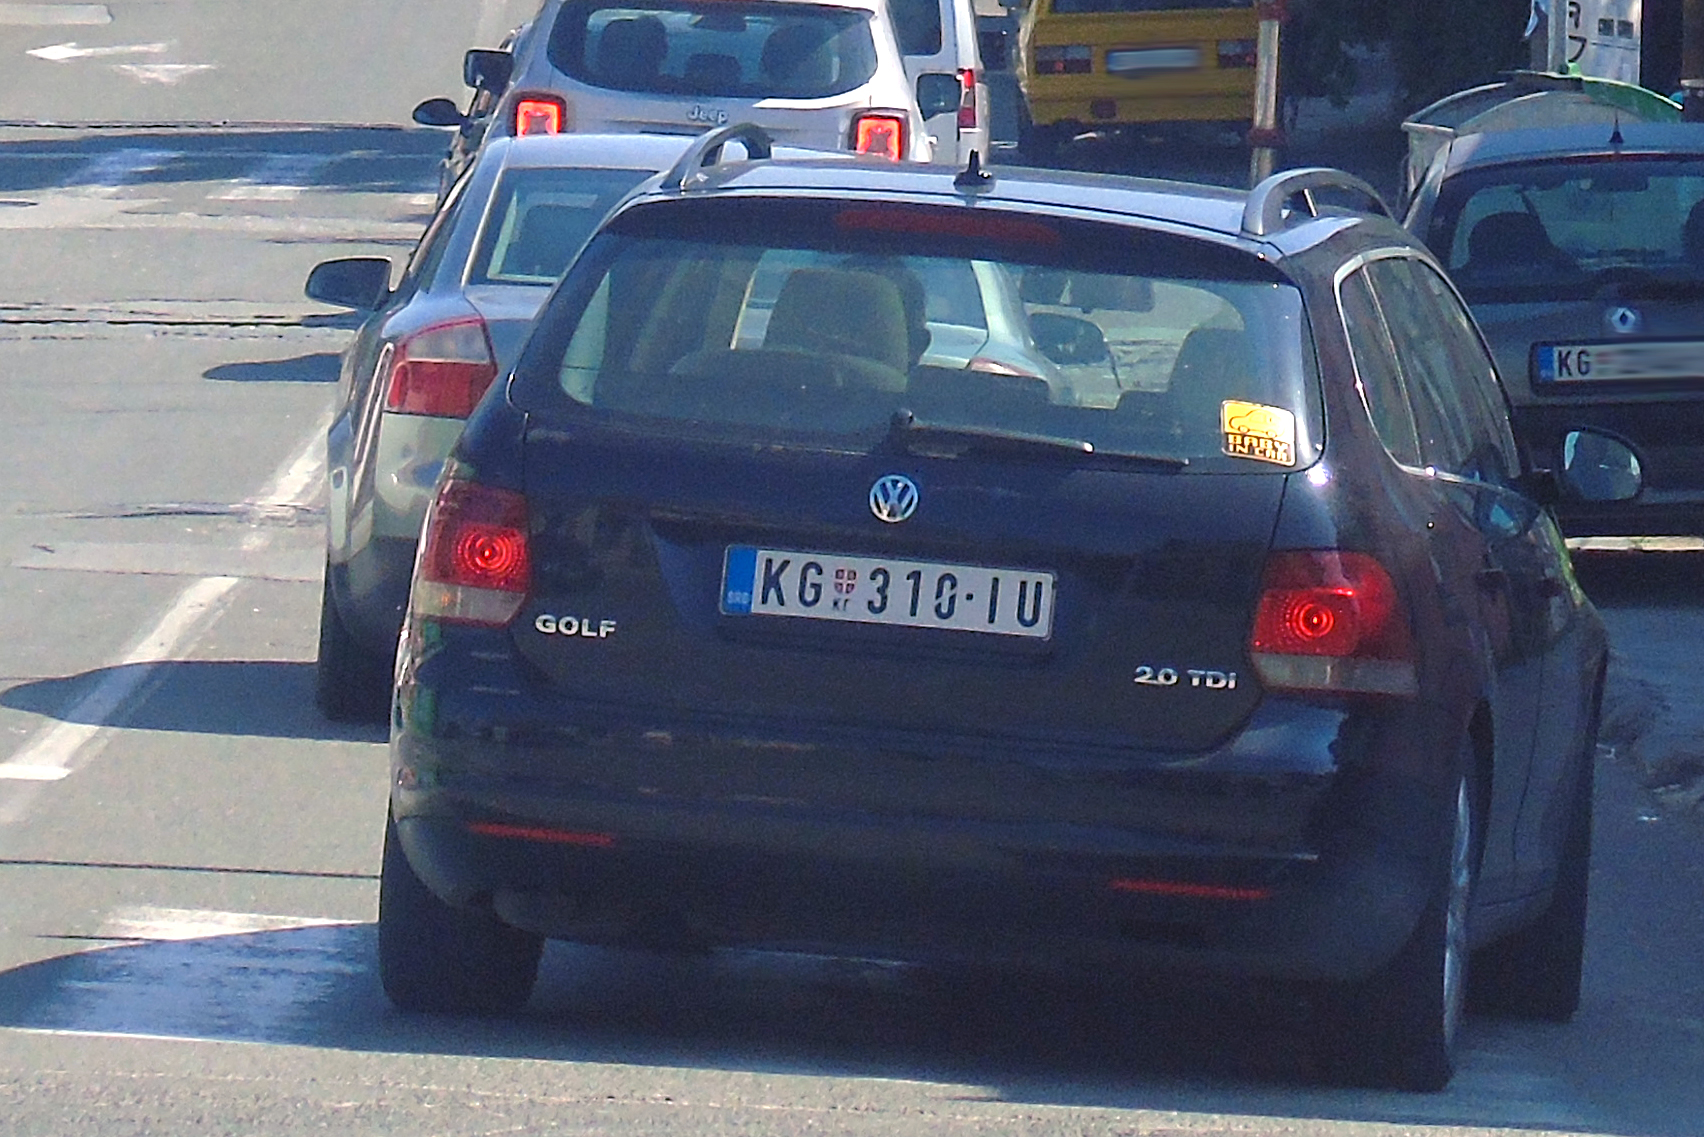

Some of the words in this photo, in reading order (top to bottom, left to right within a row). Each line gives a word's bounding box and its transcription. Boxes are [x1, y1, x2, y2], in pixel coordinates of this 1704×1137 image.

[688, 104, 728, 125] Jeep
[1558, 350, 1591, 377] KG
[1228, 434, 1288, 451] BABY
[1229, 443, 1249, 454] IN
[1254, 447, 1288, 461] CAR
[761, 558, 823, 607] KG
[535, 614, 617, 638] GOLF
